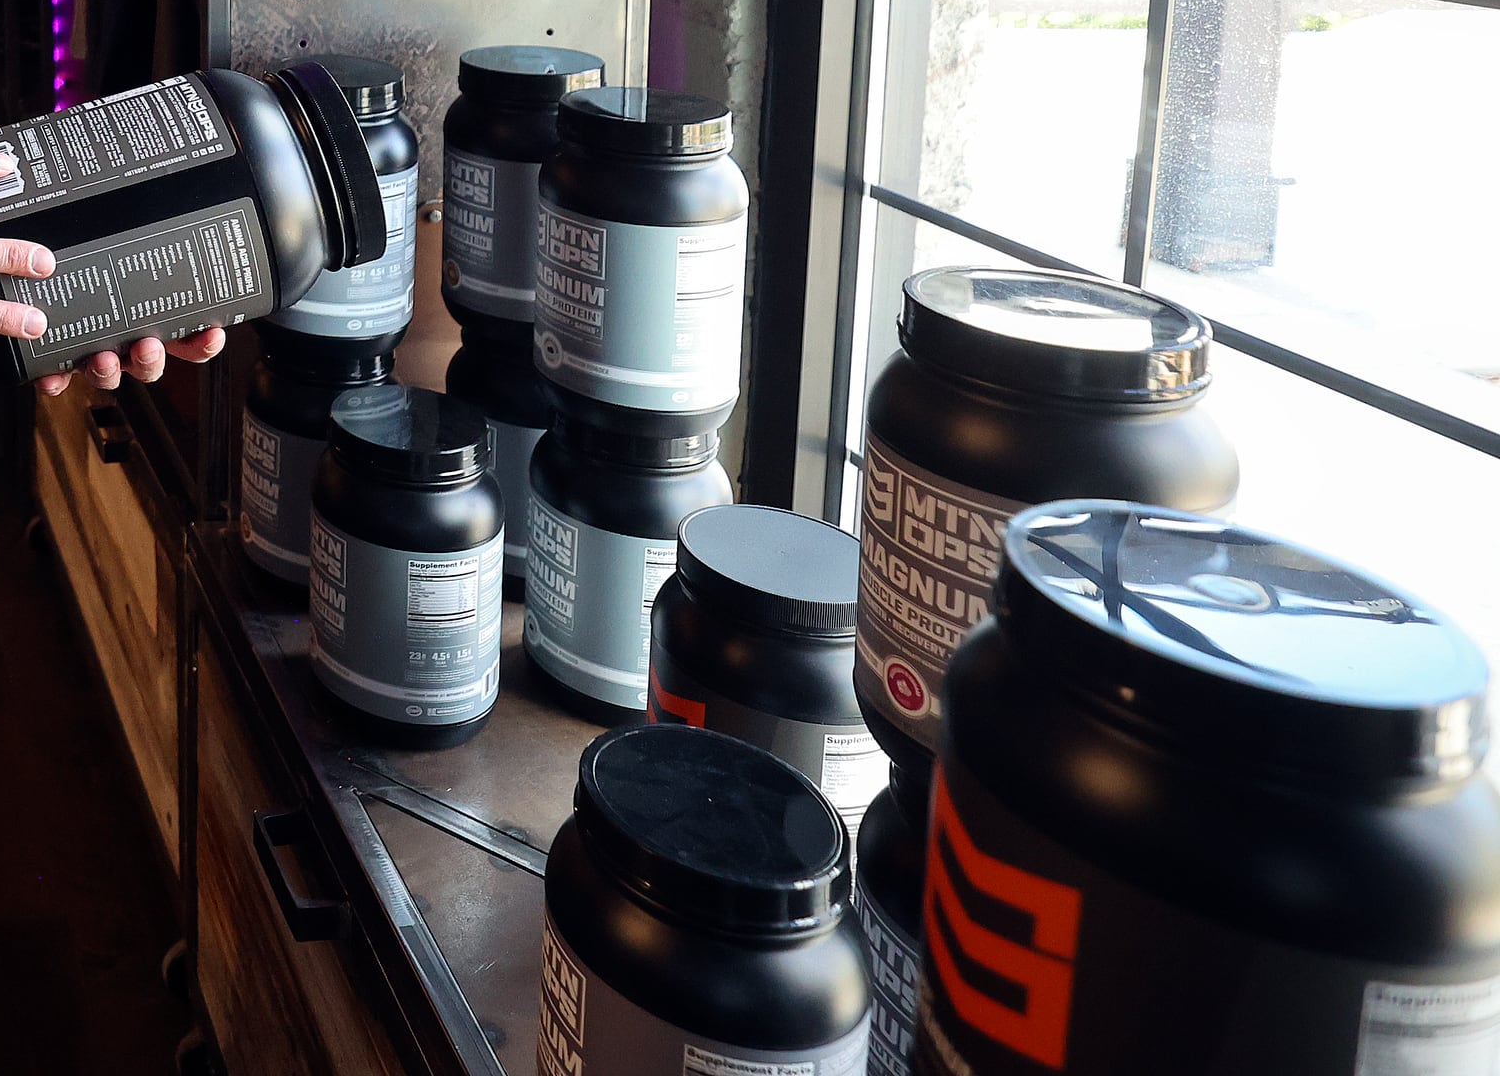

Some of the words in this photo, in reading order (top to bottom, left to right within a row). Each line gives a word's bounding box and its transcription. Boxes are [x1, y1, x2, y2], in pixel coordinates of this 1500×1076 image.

[178, 81, 199, 101] MTN
[195, 109, 218, 140] OPS
[175, 135, 185, 148] USA
[452, 159, 489, 186] MTN
[452, 177, 489, 204] OPS
[230, 217, 244, 246] AMINO
[551, 218, 599, 251] MTN
[238, 247, 249, 266] ACID
[550, 239, 599, 271] OPS
[242, 266, 254, 293] PROFILE
[553, 298, 596, 323] PROTEIN
[534, 506, 572, 548] MTN
[905, 485, 1007, 548] MTN
[534, 526, 572, 567] OPS
[904, 514, 999, 579] OPS
[410, 561, 457, 570] Supplement
[460, 558, 478, 566] Facts
[863, 564, 902, 614] MUSCLE
[908, 607, 962, 646] PROT
[687, 1047, 773, 1075] Supplement
